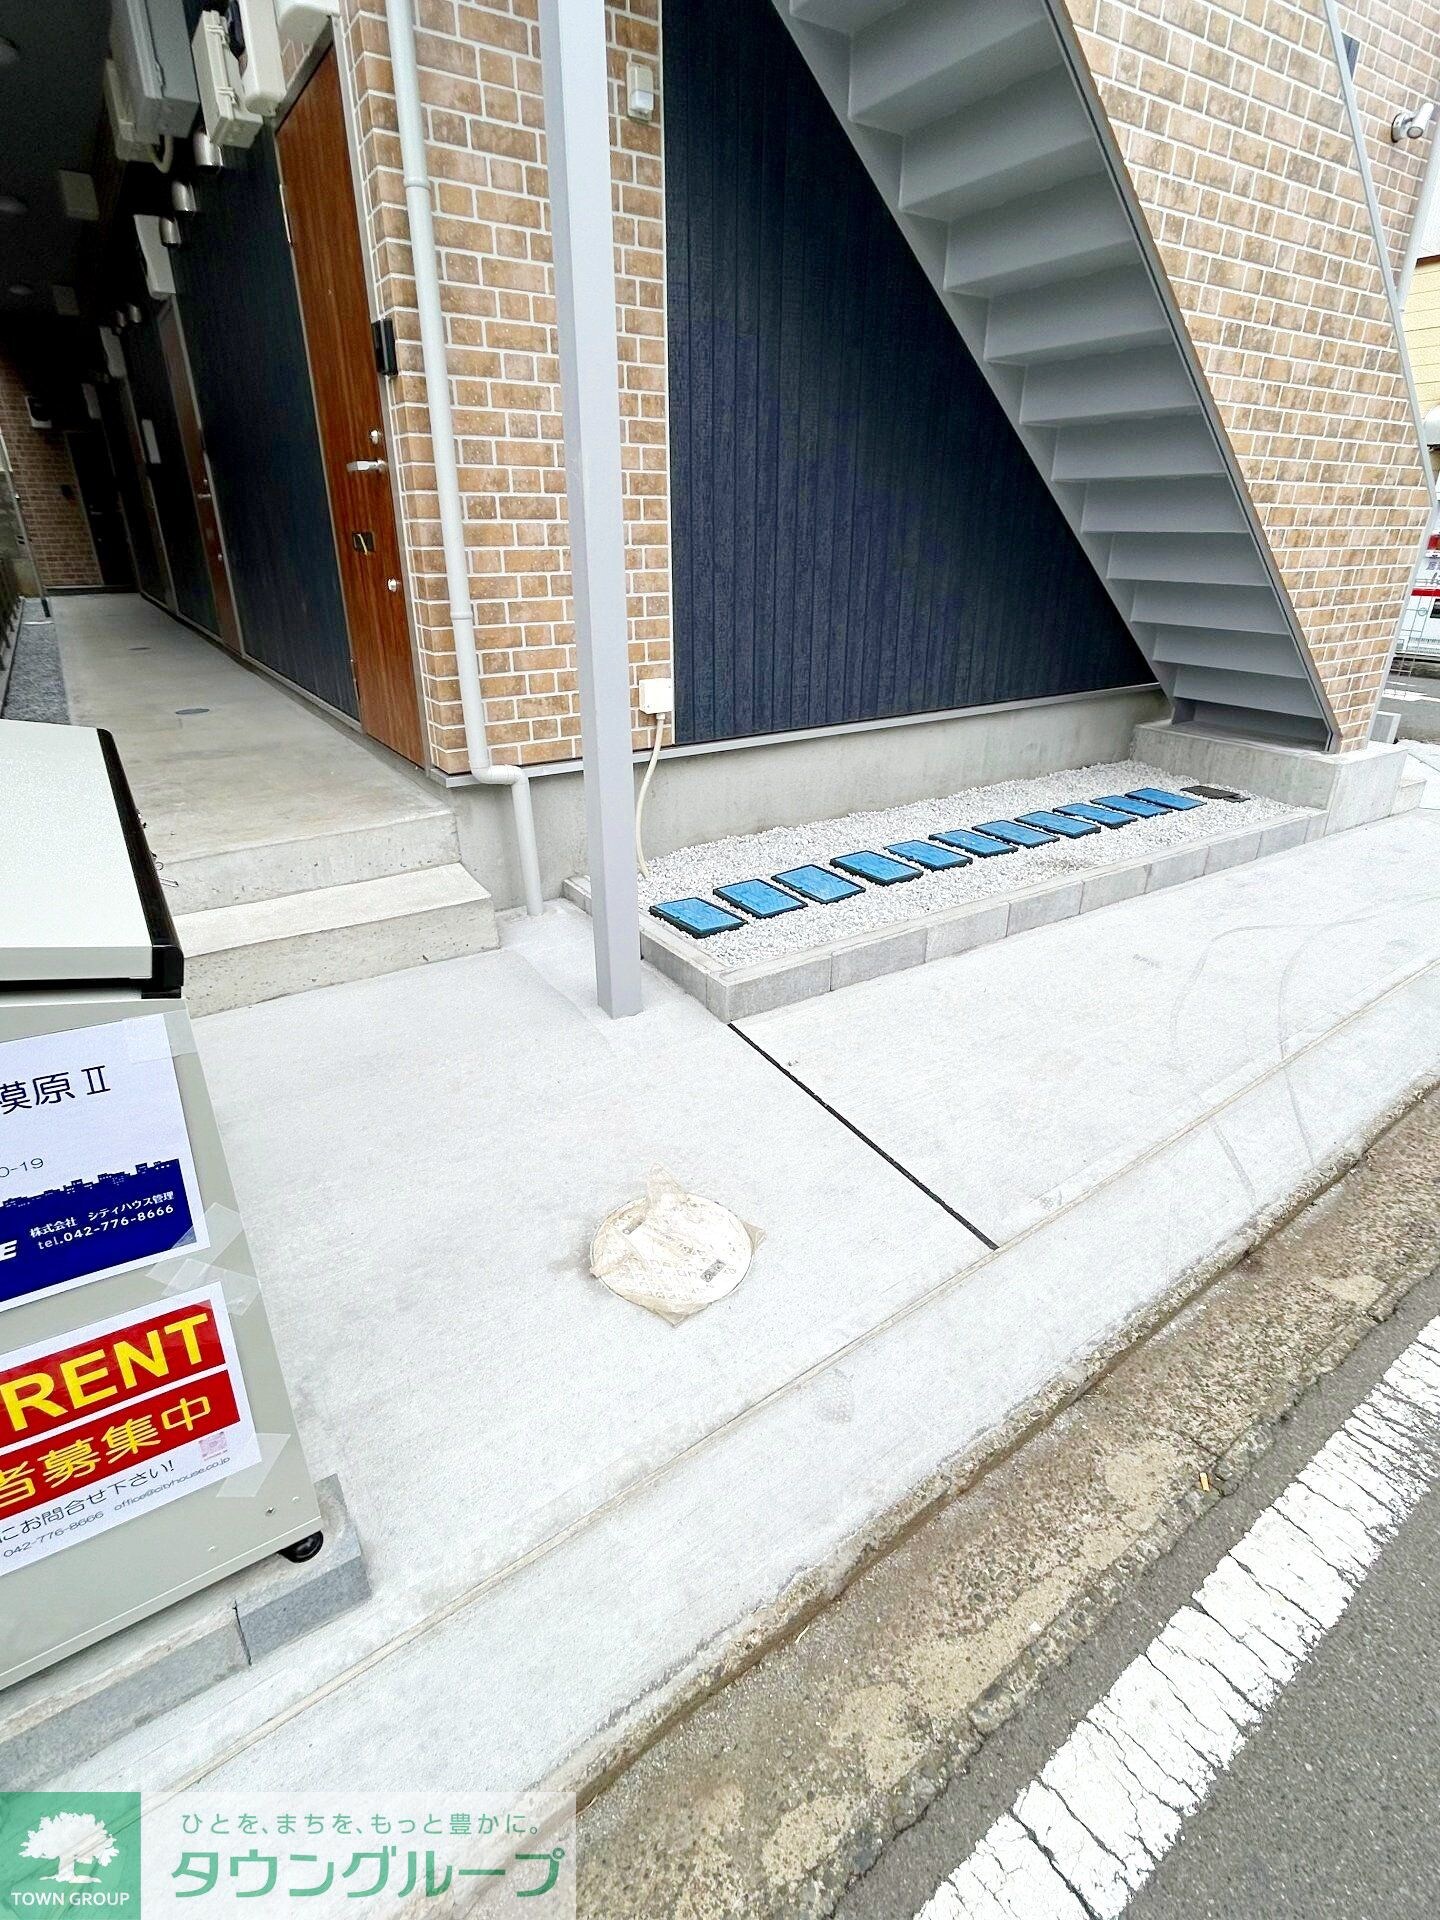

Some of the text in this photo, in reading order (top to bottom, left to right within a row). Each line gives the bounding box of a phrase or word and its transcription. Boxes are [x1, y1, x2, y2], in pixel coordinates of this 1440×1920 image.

[30, 1191, 175, 1238] 株式会社 シティハウス管理
[38, 1204, 174, 1250] tel.042-776-8666
[0, 1312, 208, 1432] RENT
